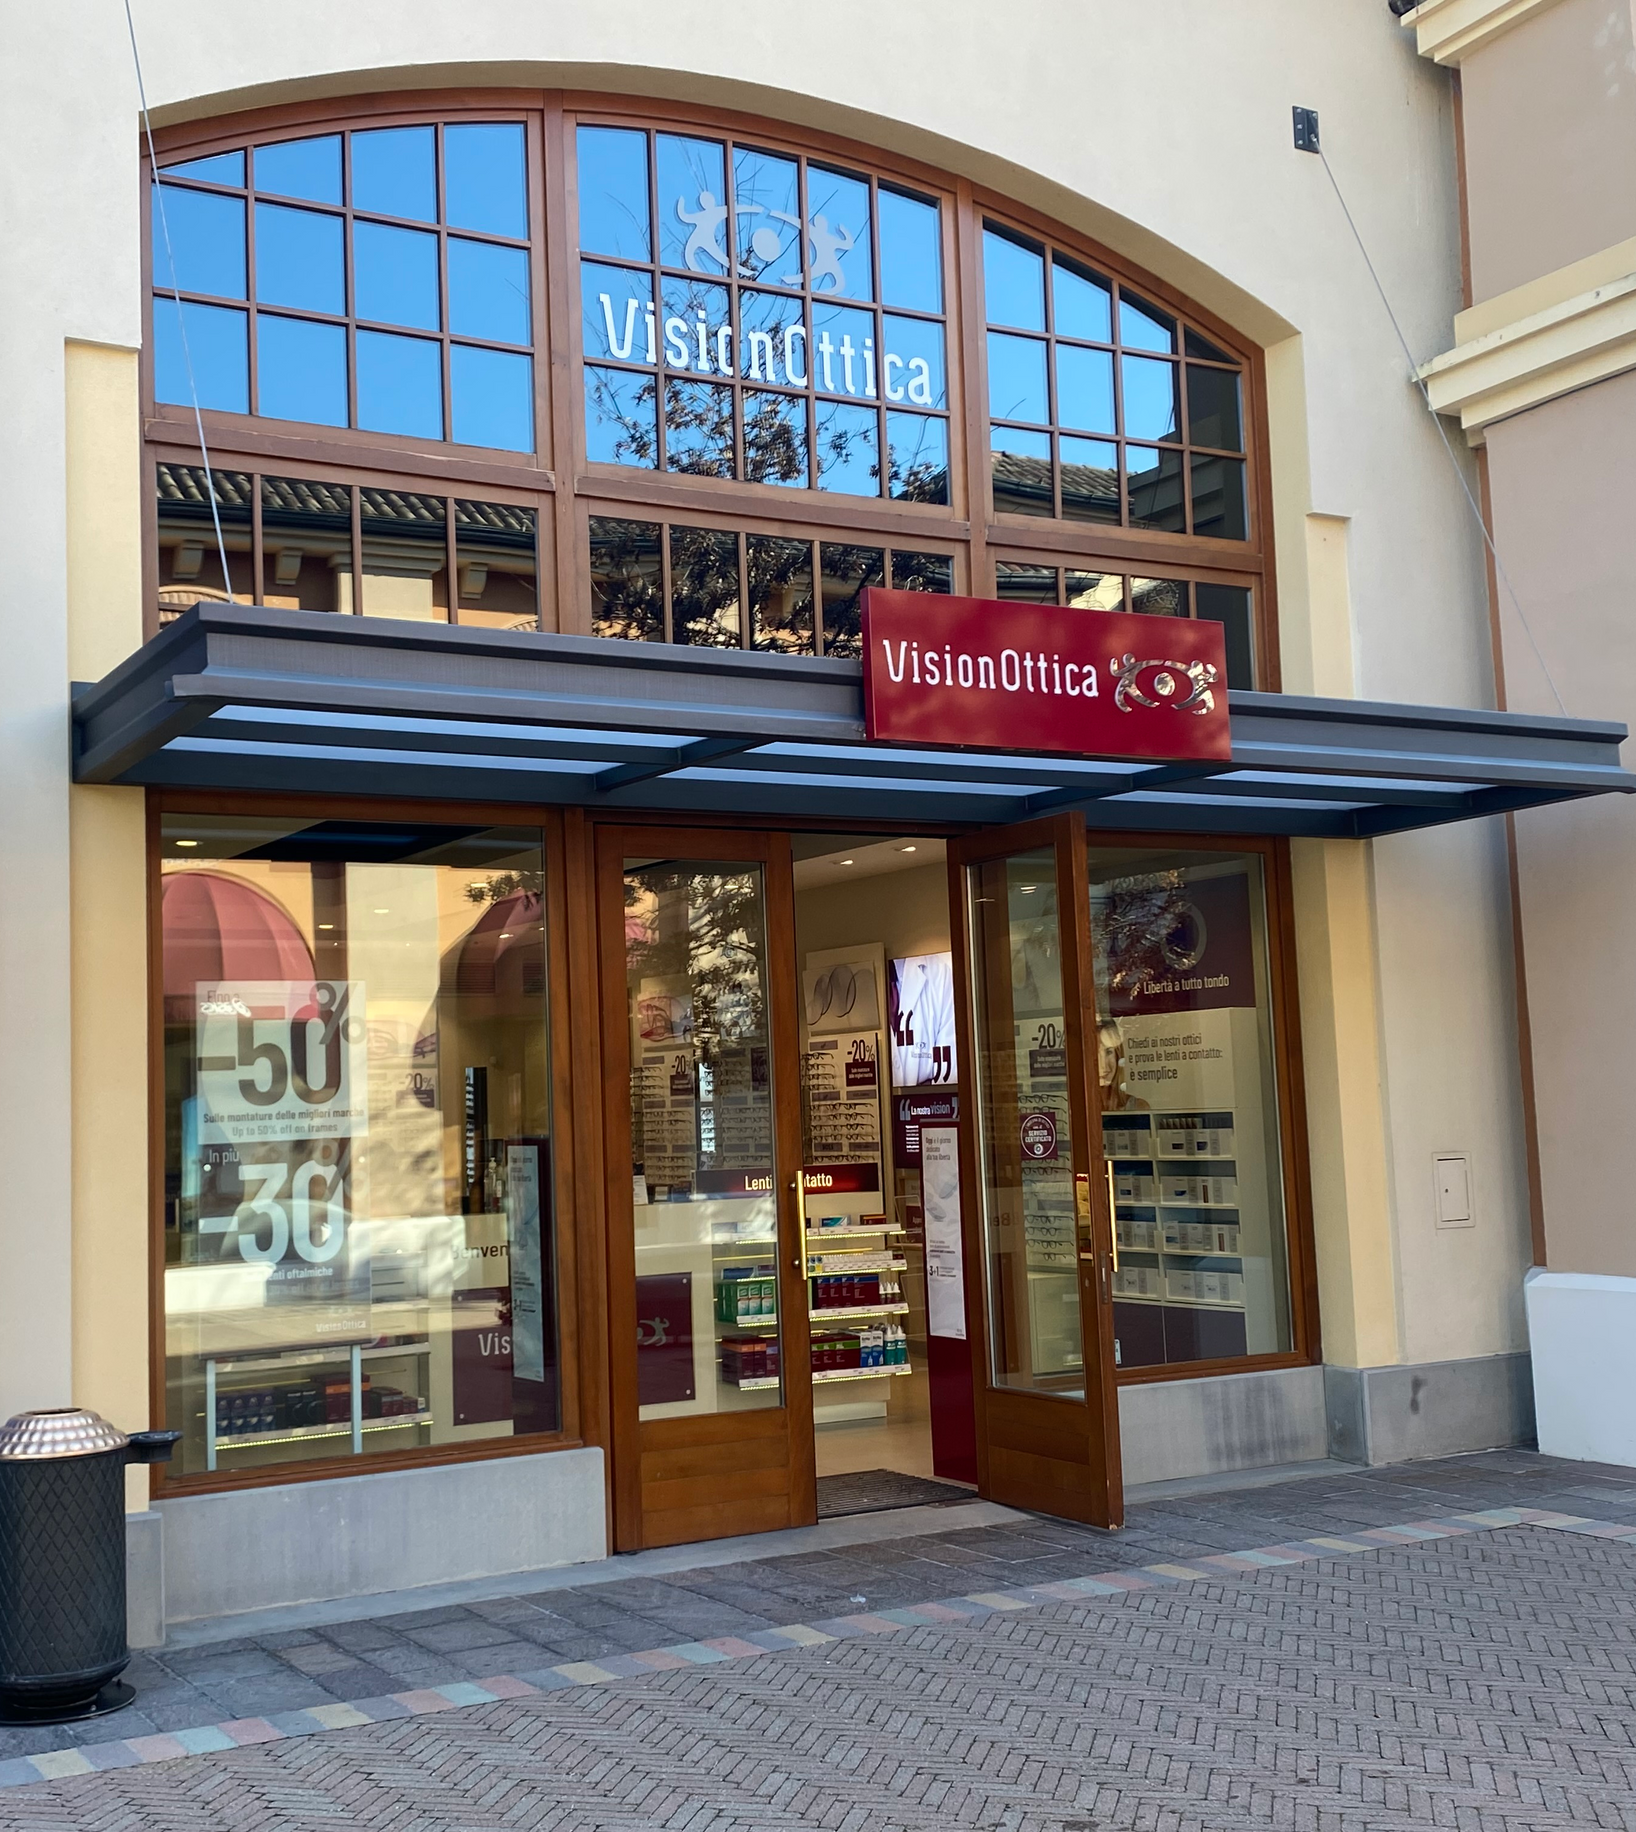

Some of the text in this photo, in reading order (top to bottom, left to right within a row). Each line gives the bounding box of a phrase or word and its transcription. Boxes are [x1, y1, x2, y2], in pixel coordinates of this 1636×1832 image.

[599, 293, 933, 406] VisionOttica
[882, 638, 1100, 698] VisionOttica
[1174, 981, 1180, 992] a
[1181, 977, 1202, 991] tutto
[1203, 974, 1230, 988] tondo
[1127, 1033, 1202, 1049] Chiedi ai nostri ottici
[846, 1039, 876, 1062] -20%
[1134, 1053, 1155, 1066] prova
[1163, 1049, 1180, 1062] lenti
[1181, 1051, 1187, 1060] a
[1137, 1066, 1178, 1083] semplice
[203, 1113, 226, 1124] Sulle
[227, 1110, 273, 1122] montature
[275, 1109, 296, 1120] delle
[298, 1108, 331, 1121] migliori
[307, 1122, 339, 1133] frames
[208, 1148, 240, 1166] In più
[744, 1173, 773, 1191] Lenti
[286, 1266, 334, 1280] oftalmiche
